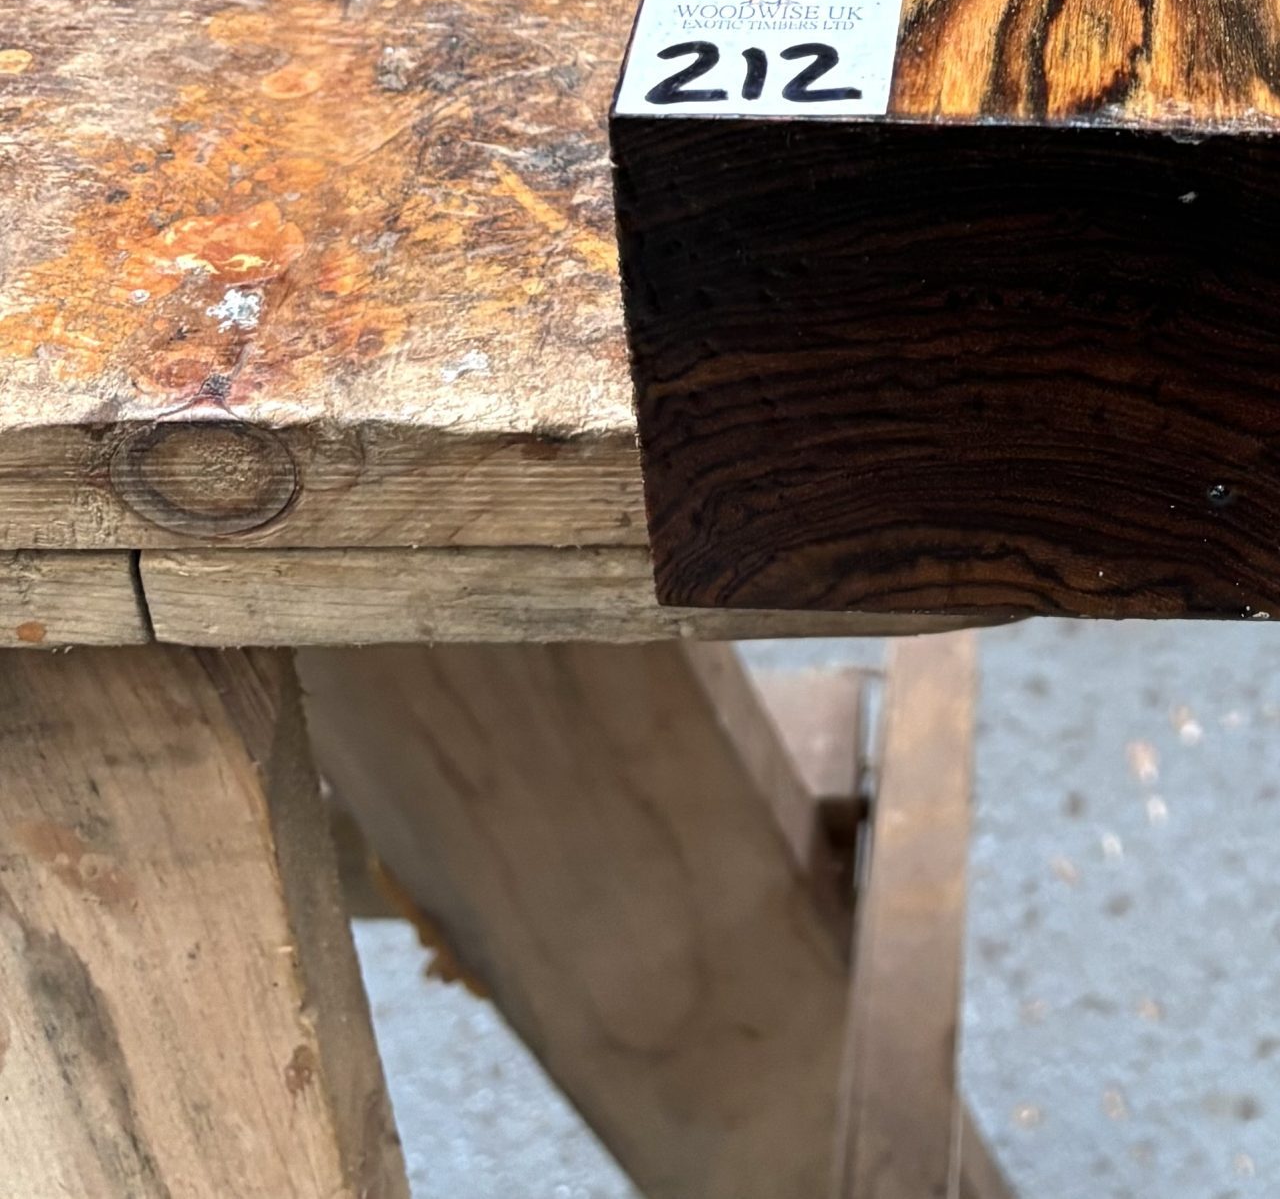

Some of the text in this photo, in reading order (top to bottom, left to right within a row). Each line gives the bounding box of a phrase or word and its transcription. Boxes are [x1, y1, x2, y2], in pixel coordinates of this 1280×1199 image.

[677, 4, 864, 21] WOODWISE UK
[682, 19, 855, 31] EXOTIC TIMBERS LTD
[645, 40, 863, 104] 212
